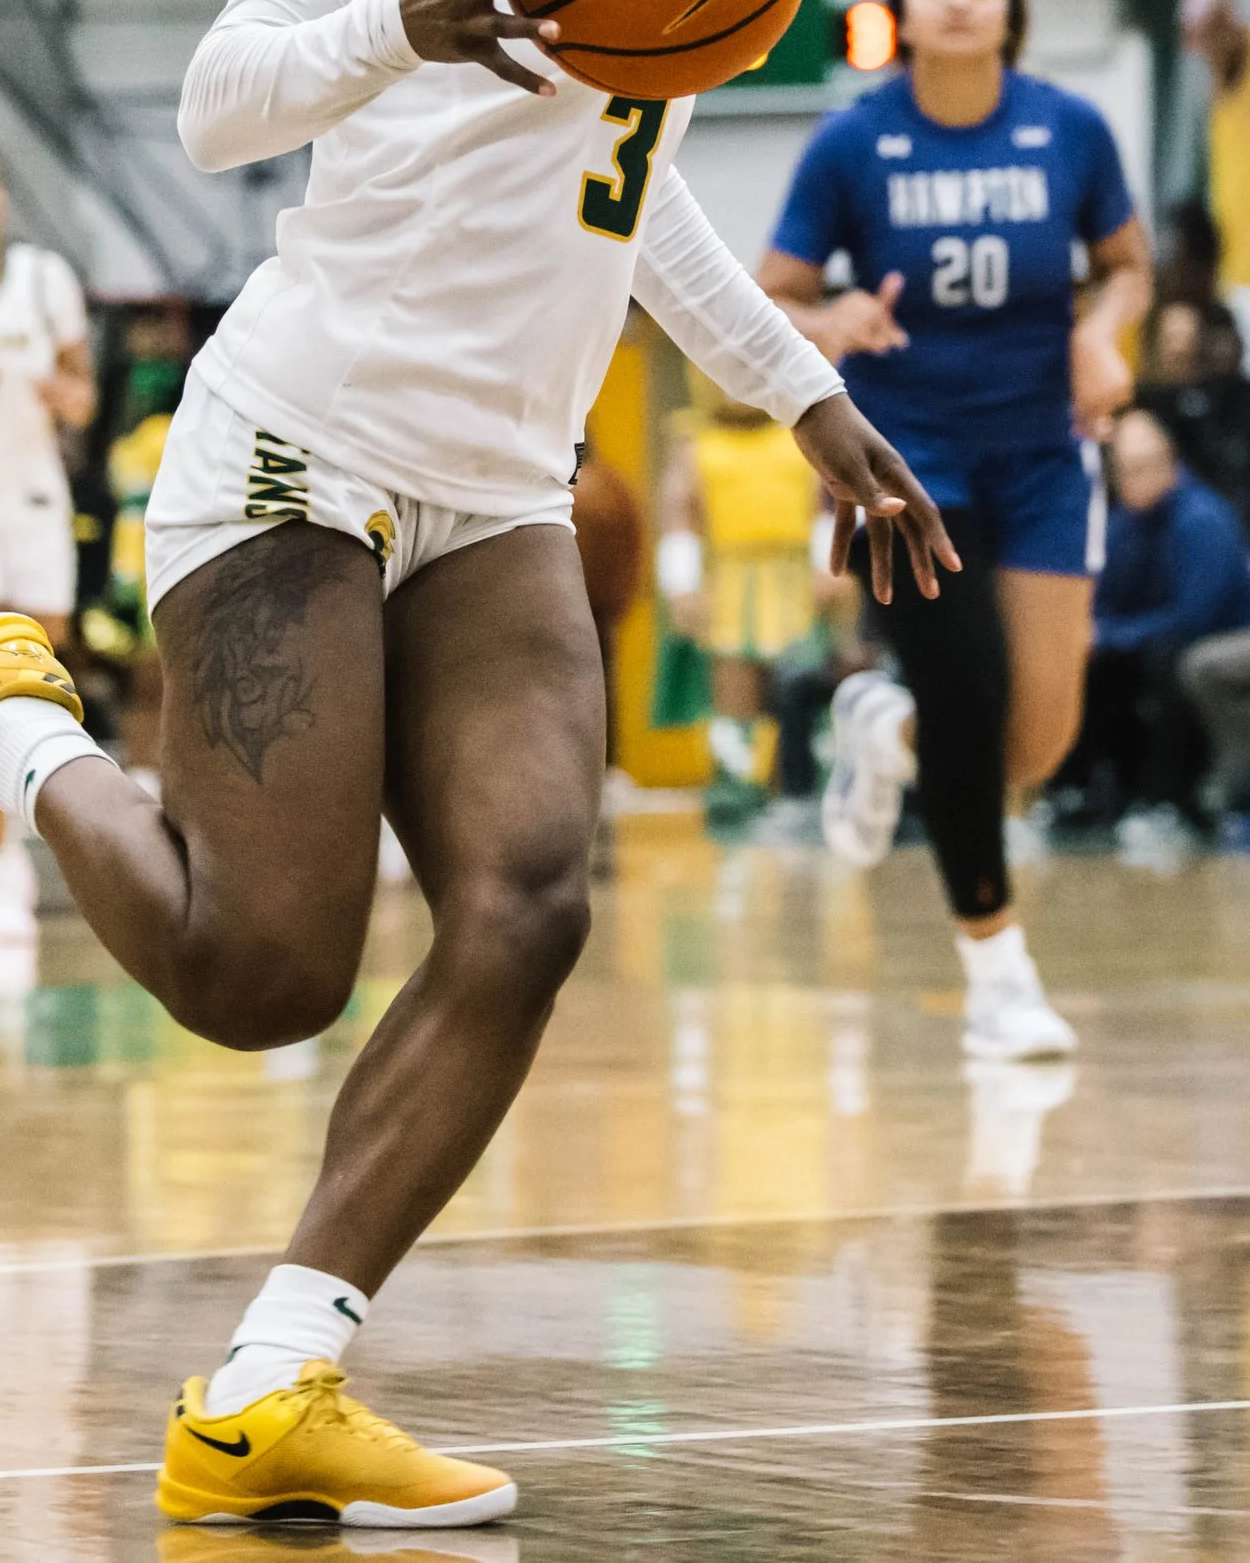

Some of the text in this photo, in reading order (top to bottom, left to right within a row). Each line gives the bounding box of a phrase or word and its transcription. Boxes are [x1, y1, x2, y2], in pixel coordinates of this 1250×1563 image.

[577, 93, 671, 244] 3
[887, 166, 1049, 228] HAMPTON
[931, 236, 1010, 309] 20
